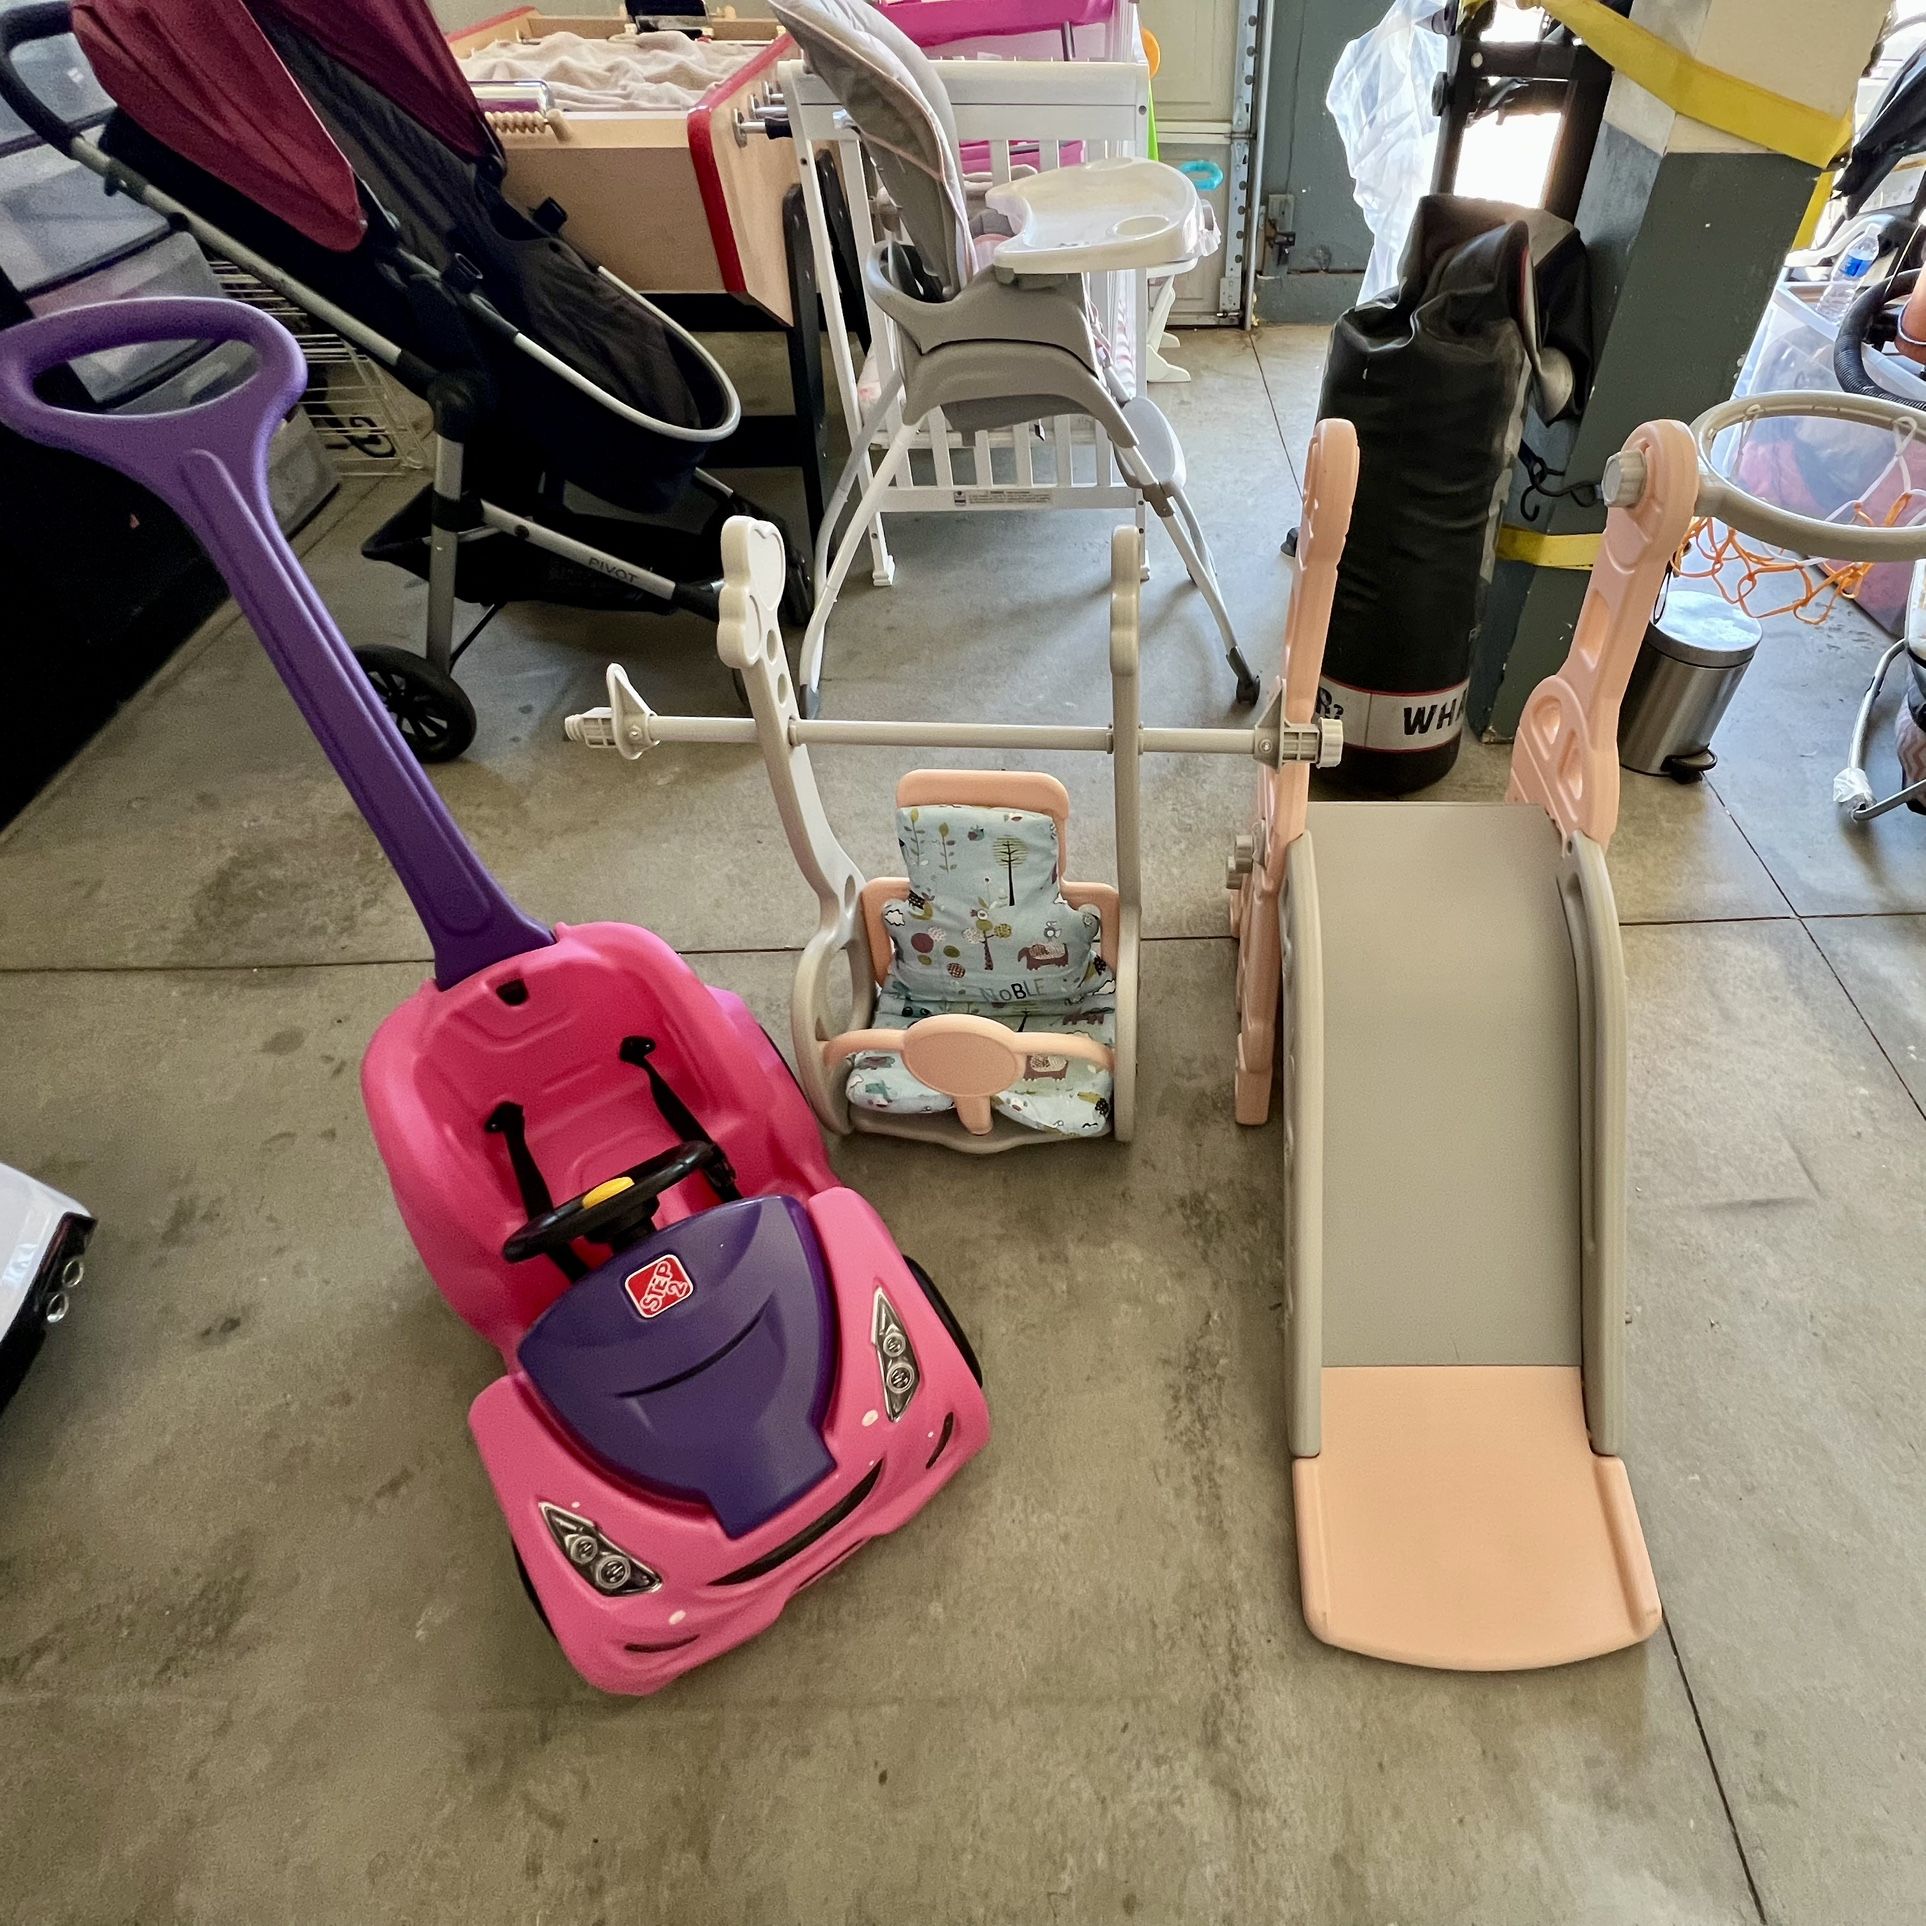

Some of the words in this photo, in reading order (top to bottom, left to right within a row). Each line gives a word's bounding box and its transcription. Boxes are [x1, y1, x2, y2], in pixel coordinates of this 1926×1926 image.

[588, 556, 638, 583] PIVOT
[640, 1261, 673, 1312] STEP
[665, 1280, 688, 1298] 2
